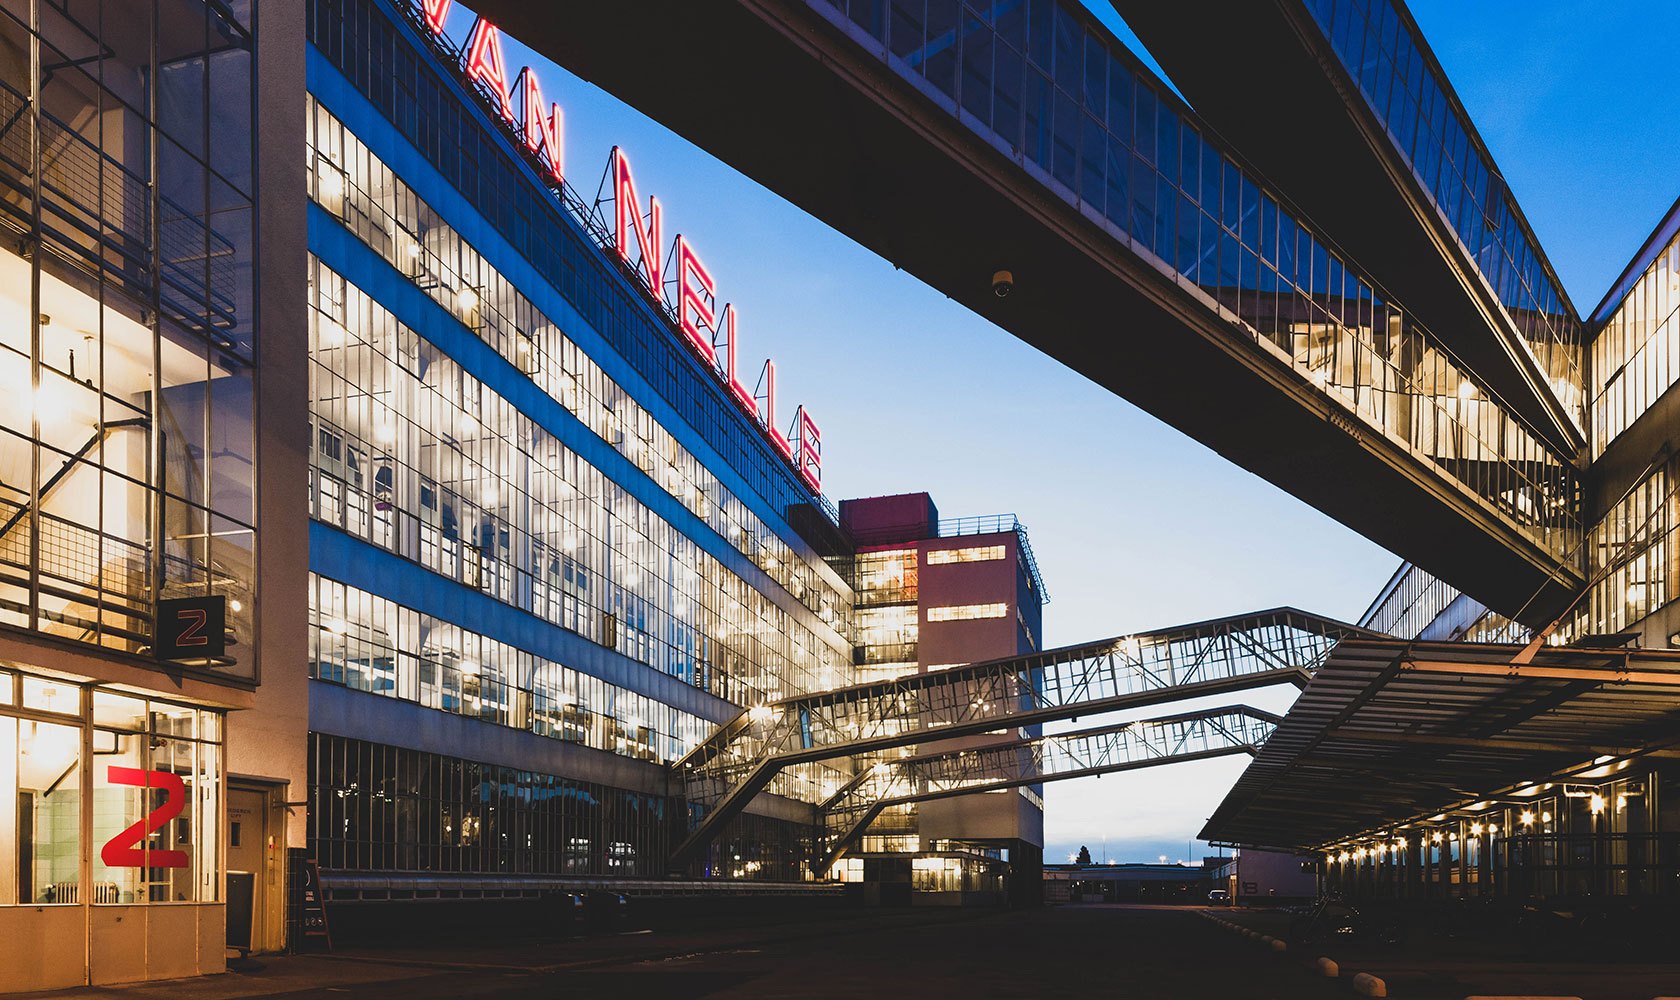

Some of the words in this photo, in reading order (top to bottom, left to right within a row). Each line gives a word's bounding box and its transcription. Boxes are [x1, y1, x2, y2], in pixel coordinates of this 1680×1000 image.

[615, 146, 822, 495] NELLE
[176, 609, 208, 647] 2
[101, 765, 189, 868] 2
